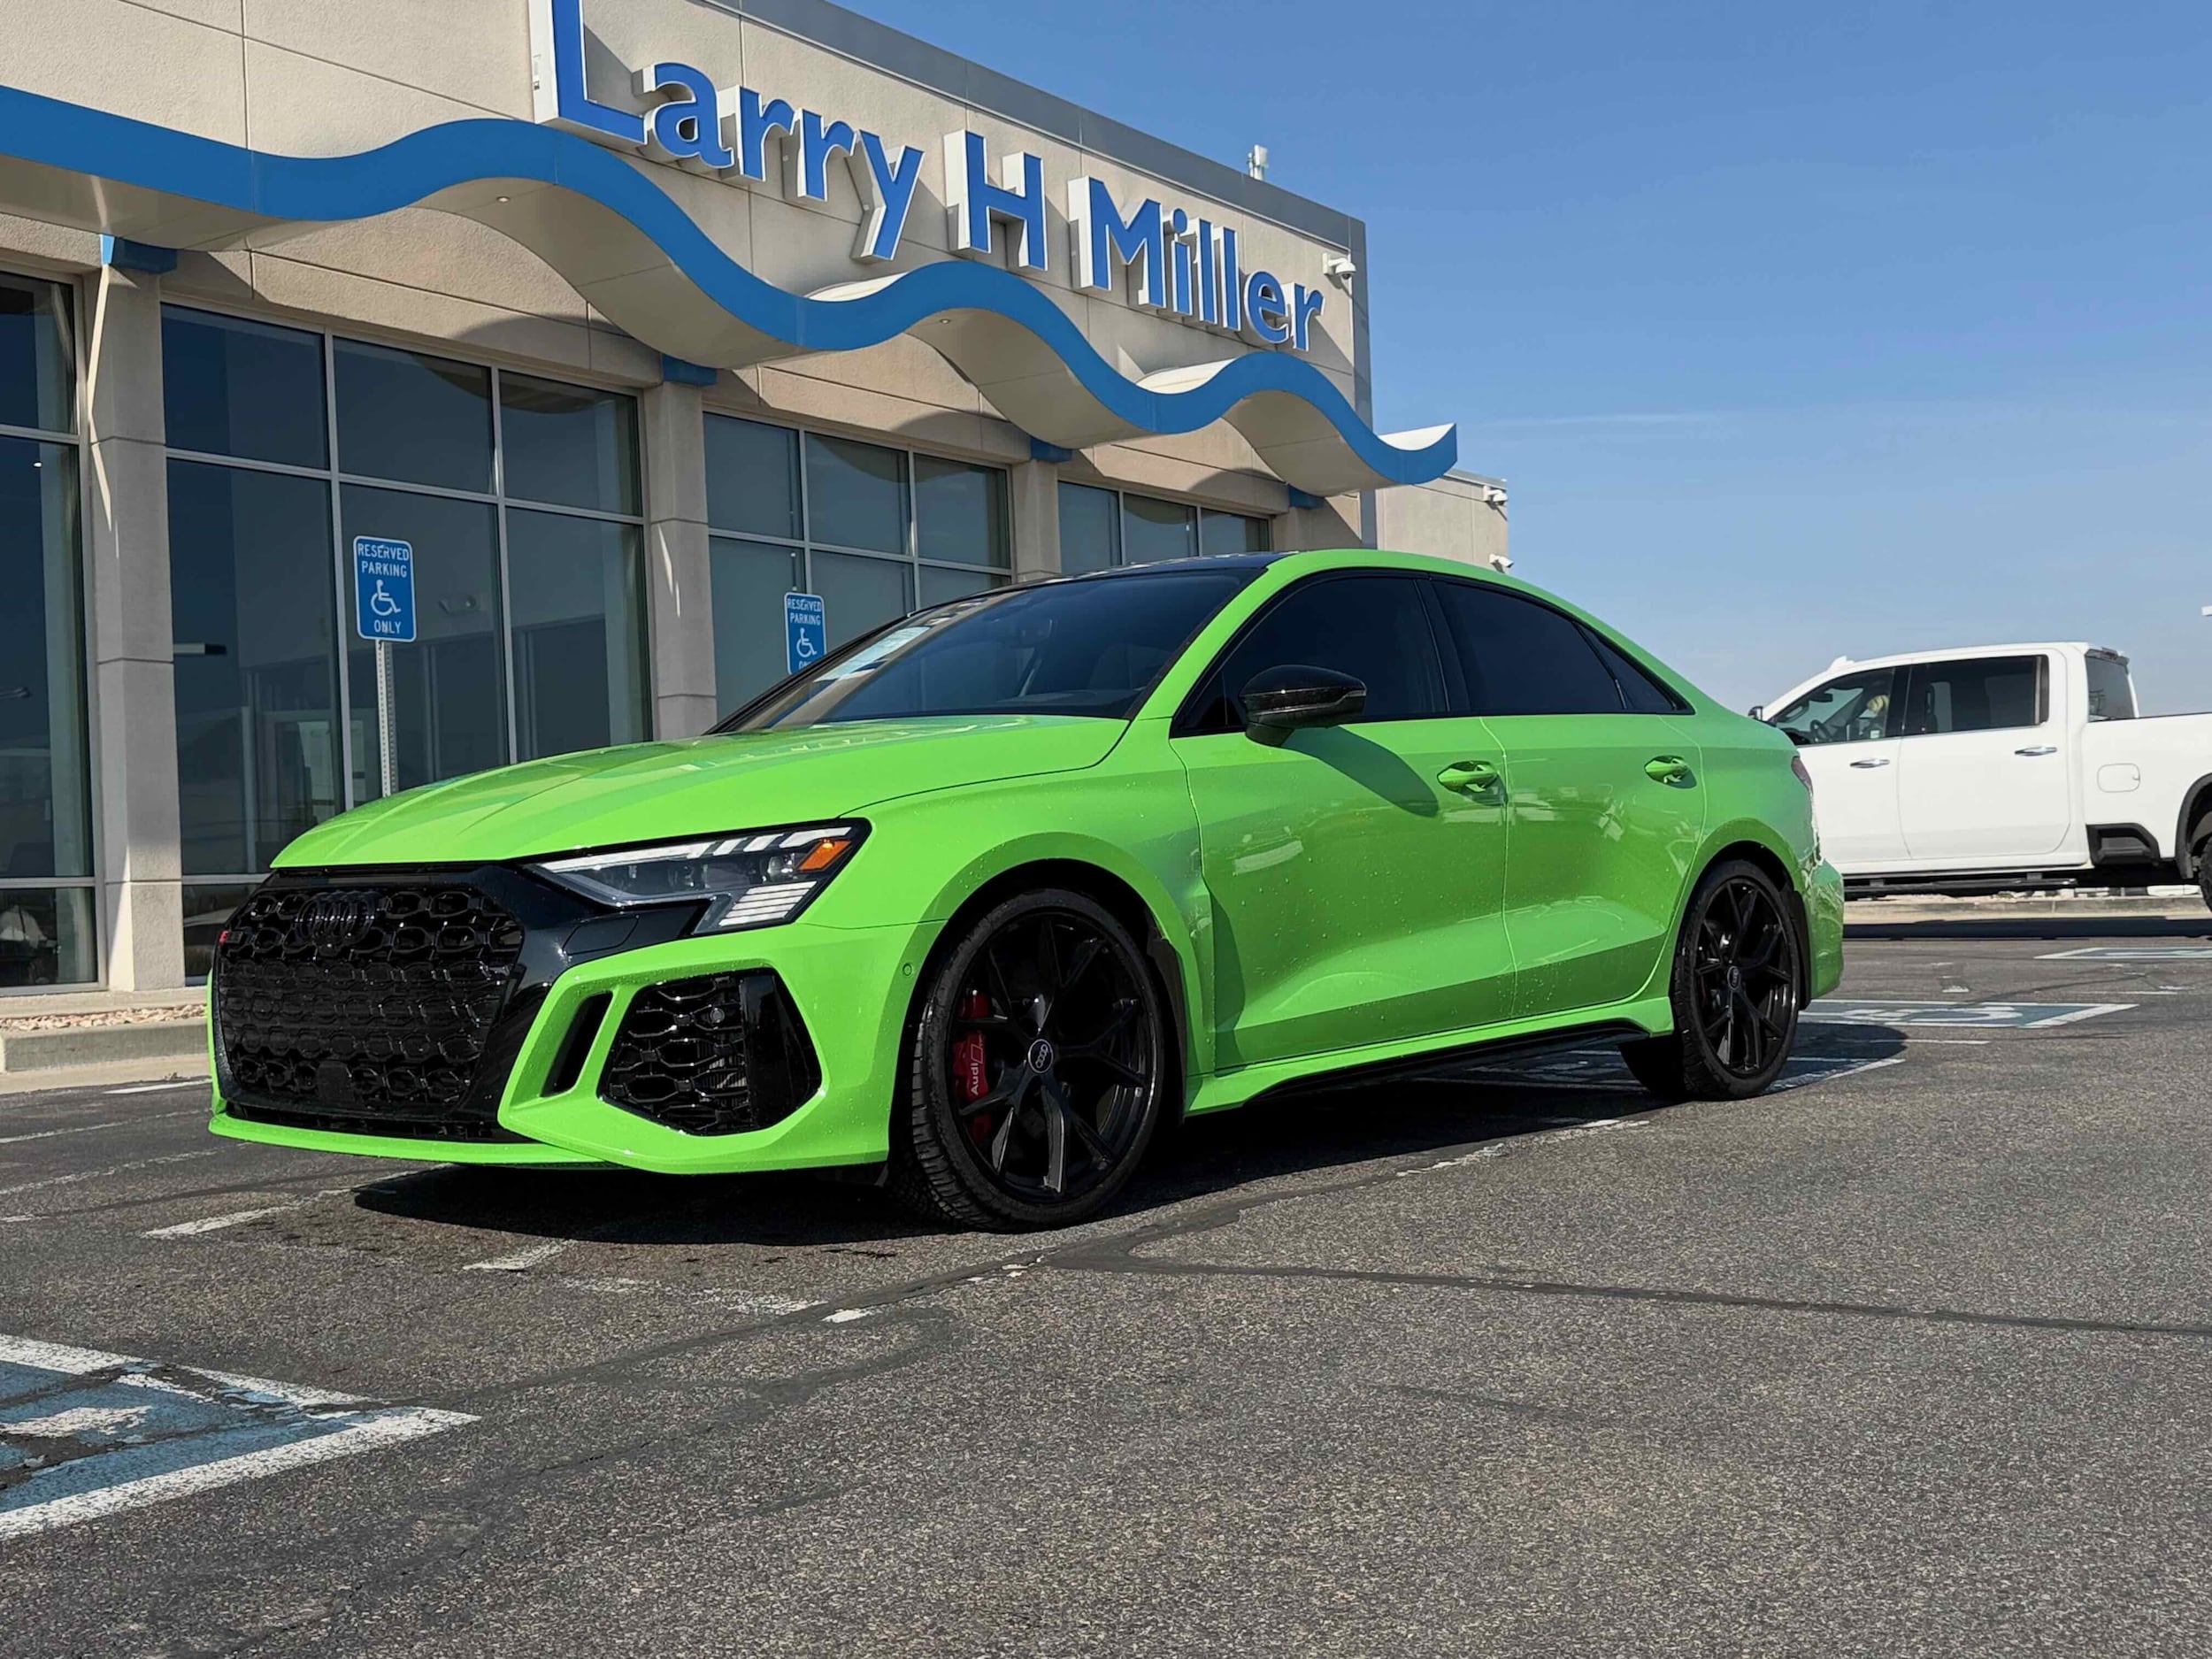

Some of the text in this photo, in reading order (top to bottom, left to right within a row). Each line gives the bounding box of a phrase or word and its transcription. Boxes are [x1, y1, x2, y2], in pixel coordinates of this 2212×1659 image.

[531, 0, 1325, 351] Larry H Miller
[357, 542, 410, 561] RESERVED
[361, 560, 408, 578] PARKING
[787, 597, 822, 612] RESERVED
[373, 619, 402, 634] ONLY
[789, 612, 821, 626] PARKING
[971, 1063, 979, 1095] Audi
